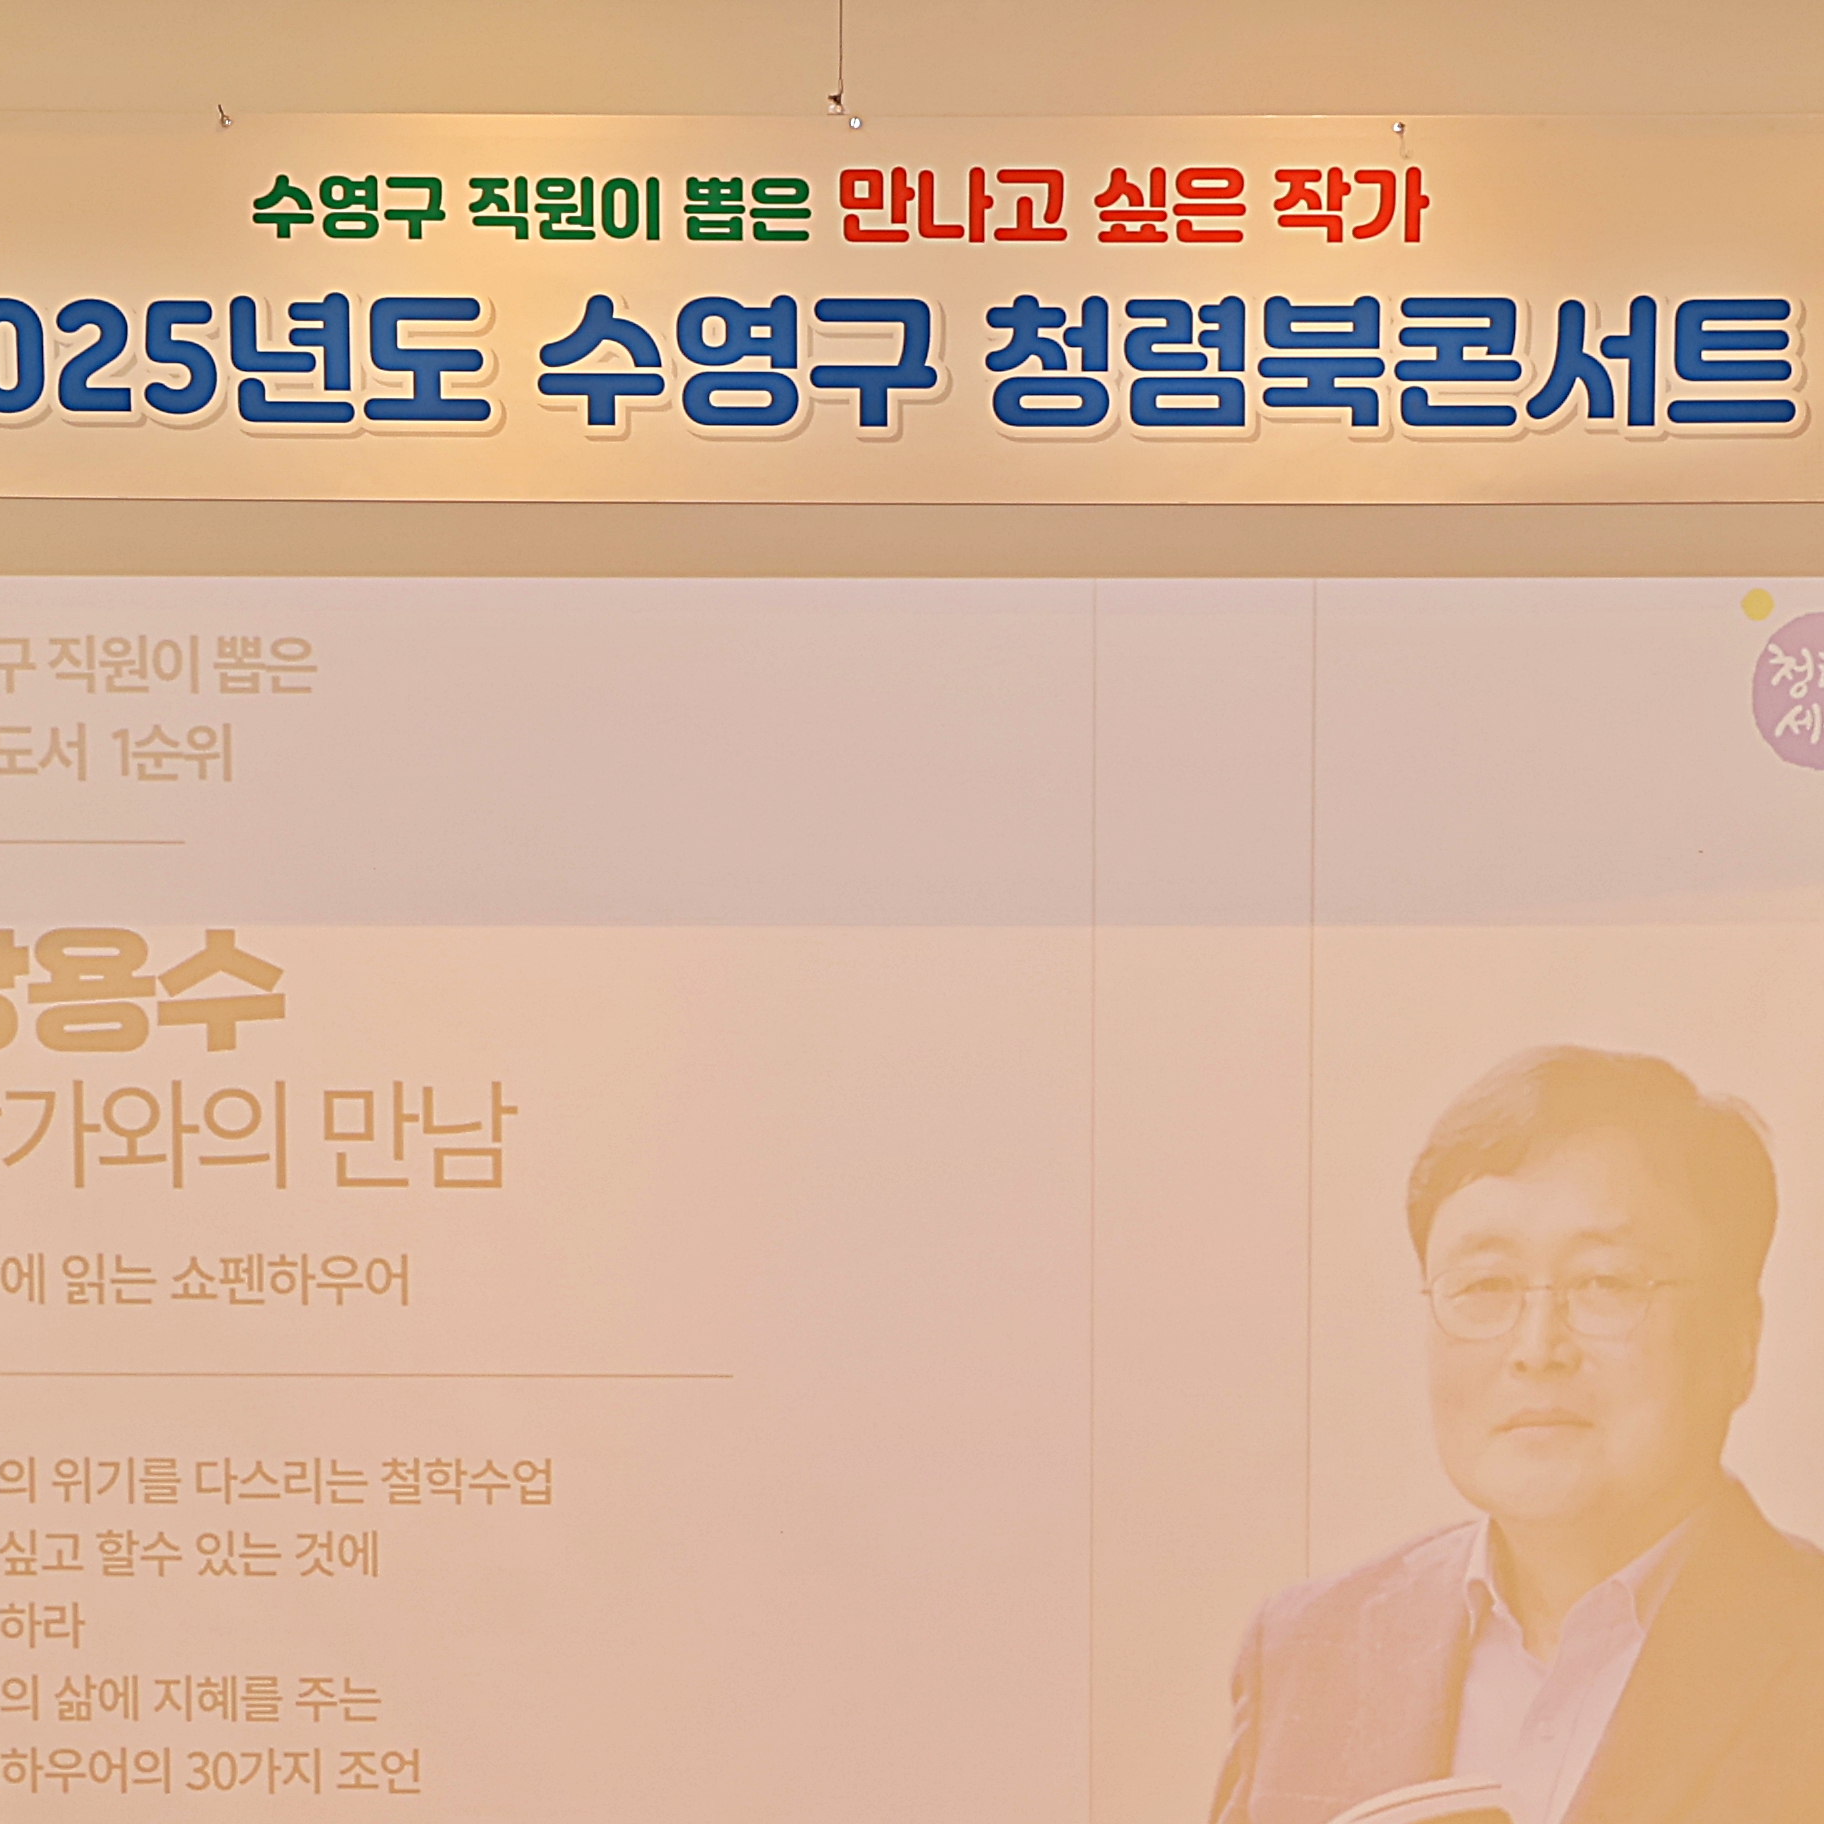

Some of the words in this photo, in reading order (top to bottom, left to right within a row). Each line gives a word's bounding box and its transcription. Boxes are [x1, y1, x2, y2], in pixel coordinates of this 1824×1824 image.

[251, 174, 447, 240] 수영구
[468, 175, 661, 241] 직원이
[683, 176, 812, 242] 뽑은
[839, 166, 1068, 244] 만나고
[1093, 166, 1247, 244] 싶은
[1273, 166, 1431, 244] 작가
[537, 294, 938, 428] 수영구
[984, 294, 1794, 428] 청렴북콘서트
[47, 634, 200, 695] 직원이
[212, 635, 319, 695] 뽑은
[111, 722, 233, 783] 1순위
[323, 1080, 519, 1189] 만남
[61, 1252, 158, 1306] 읽는
[170, 1252, 409, 1307] 쇼펜하우어
[51, 1456, 182, 1505] 위기를
[195, 1456, 369, 1506] 다스리는
[380, 1457, 552, 1506] 철학수업
[95, 1529, 183, 1578] 할수
[195, 1529, 283, 1577] 있는
[294, 1529, 379, 1578] 것에
[54, 1673, 140, 1722] 삶에
[153, 1674, 284, 1723] 지혜를
[294, 1676, 382, 1723] 주는
[185, 1747, 321, 1795] 30가지
[336, 1747, 422, 1795] 조언
